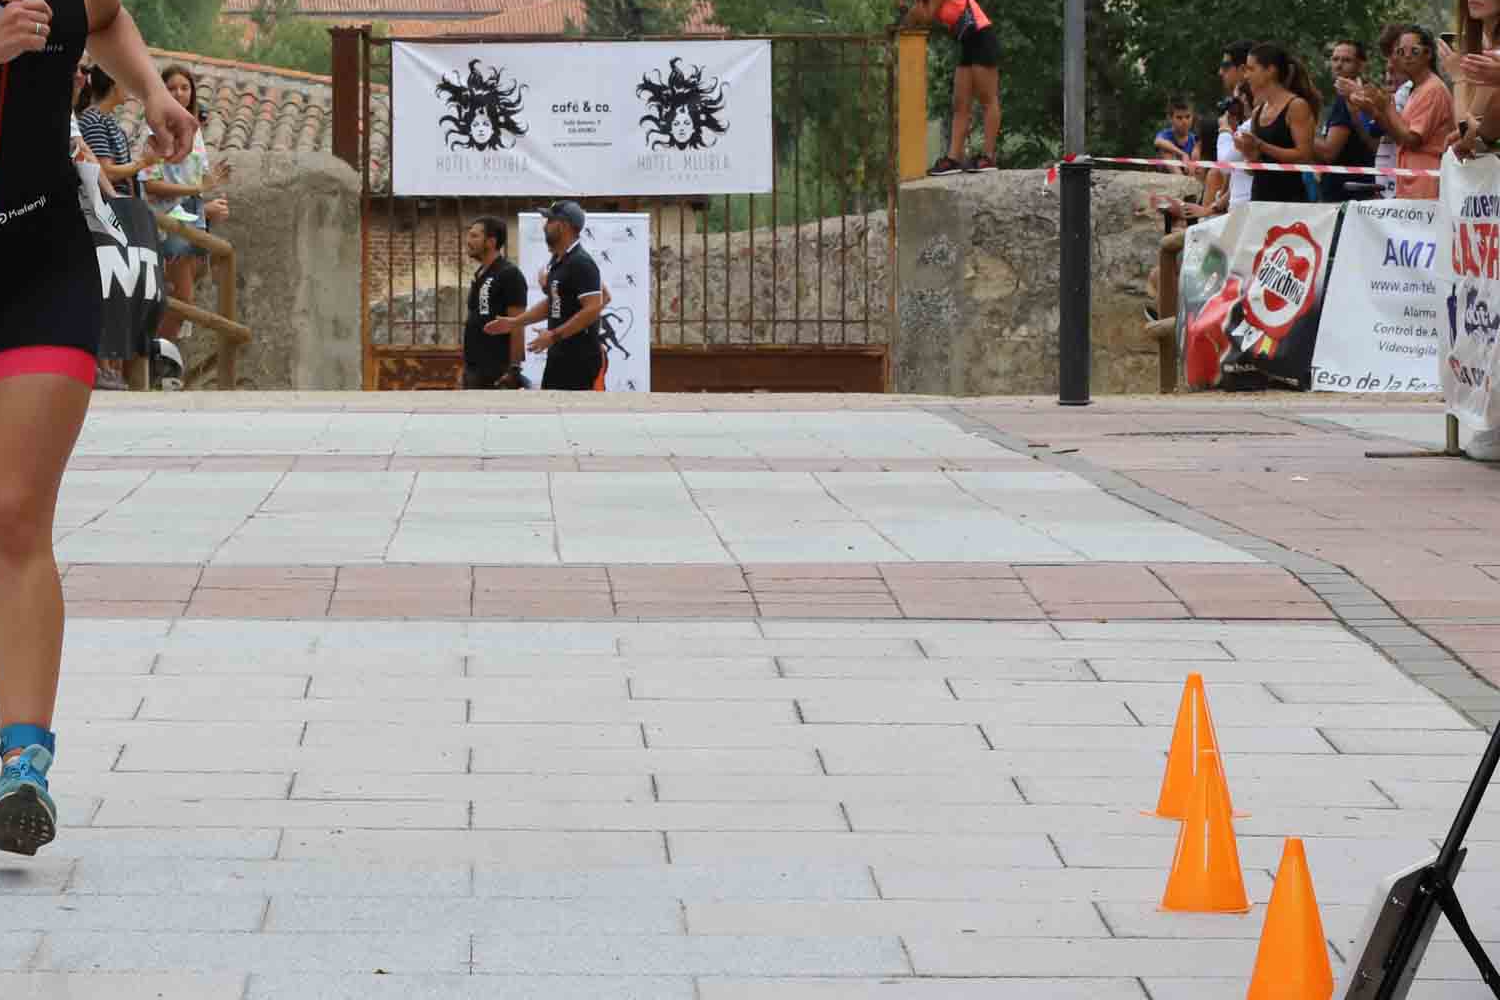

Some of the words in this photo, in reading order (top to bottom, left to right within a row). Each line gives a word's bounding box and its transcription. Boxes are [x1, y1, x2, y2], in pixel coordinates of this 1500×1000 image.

[583, 100, 591, 113] &
[8, 195, 47, 219] Kalenji
[1427, 208, 1435, 224] y
[1373, 322, 1413, 337] Control
[1311, 366, 1351, 388] Teso
[1355, 372, 1380, 390] de
